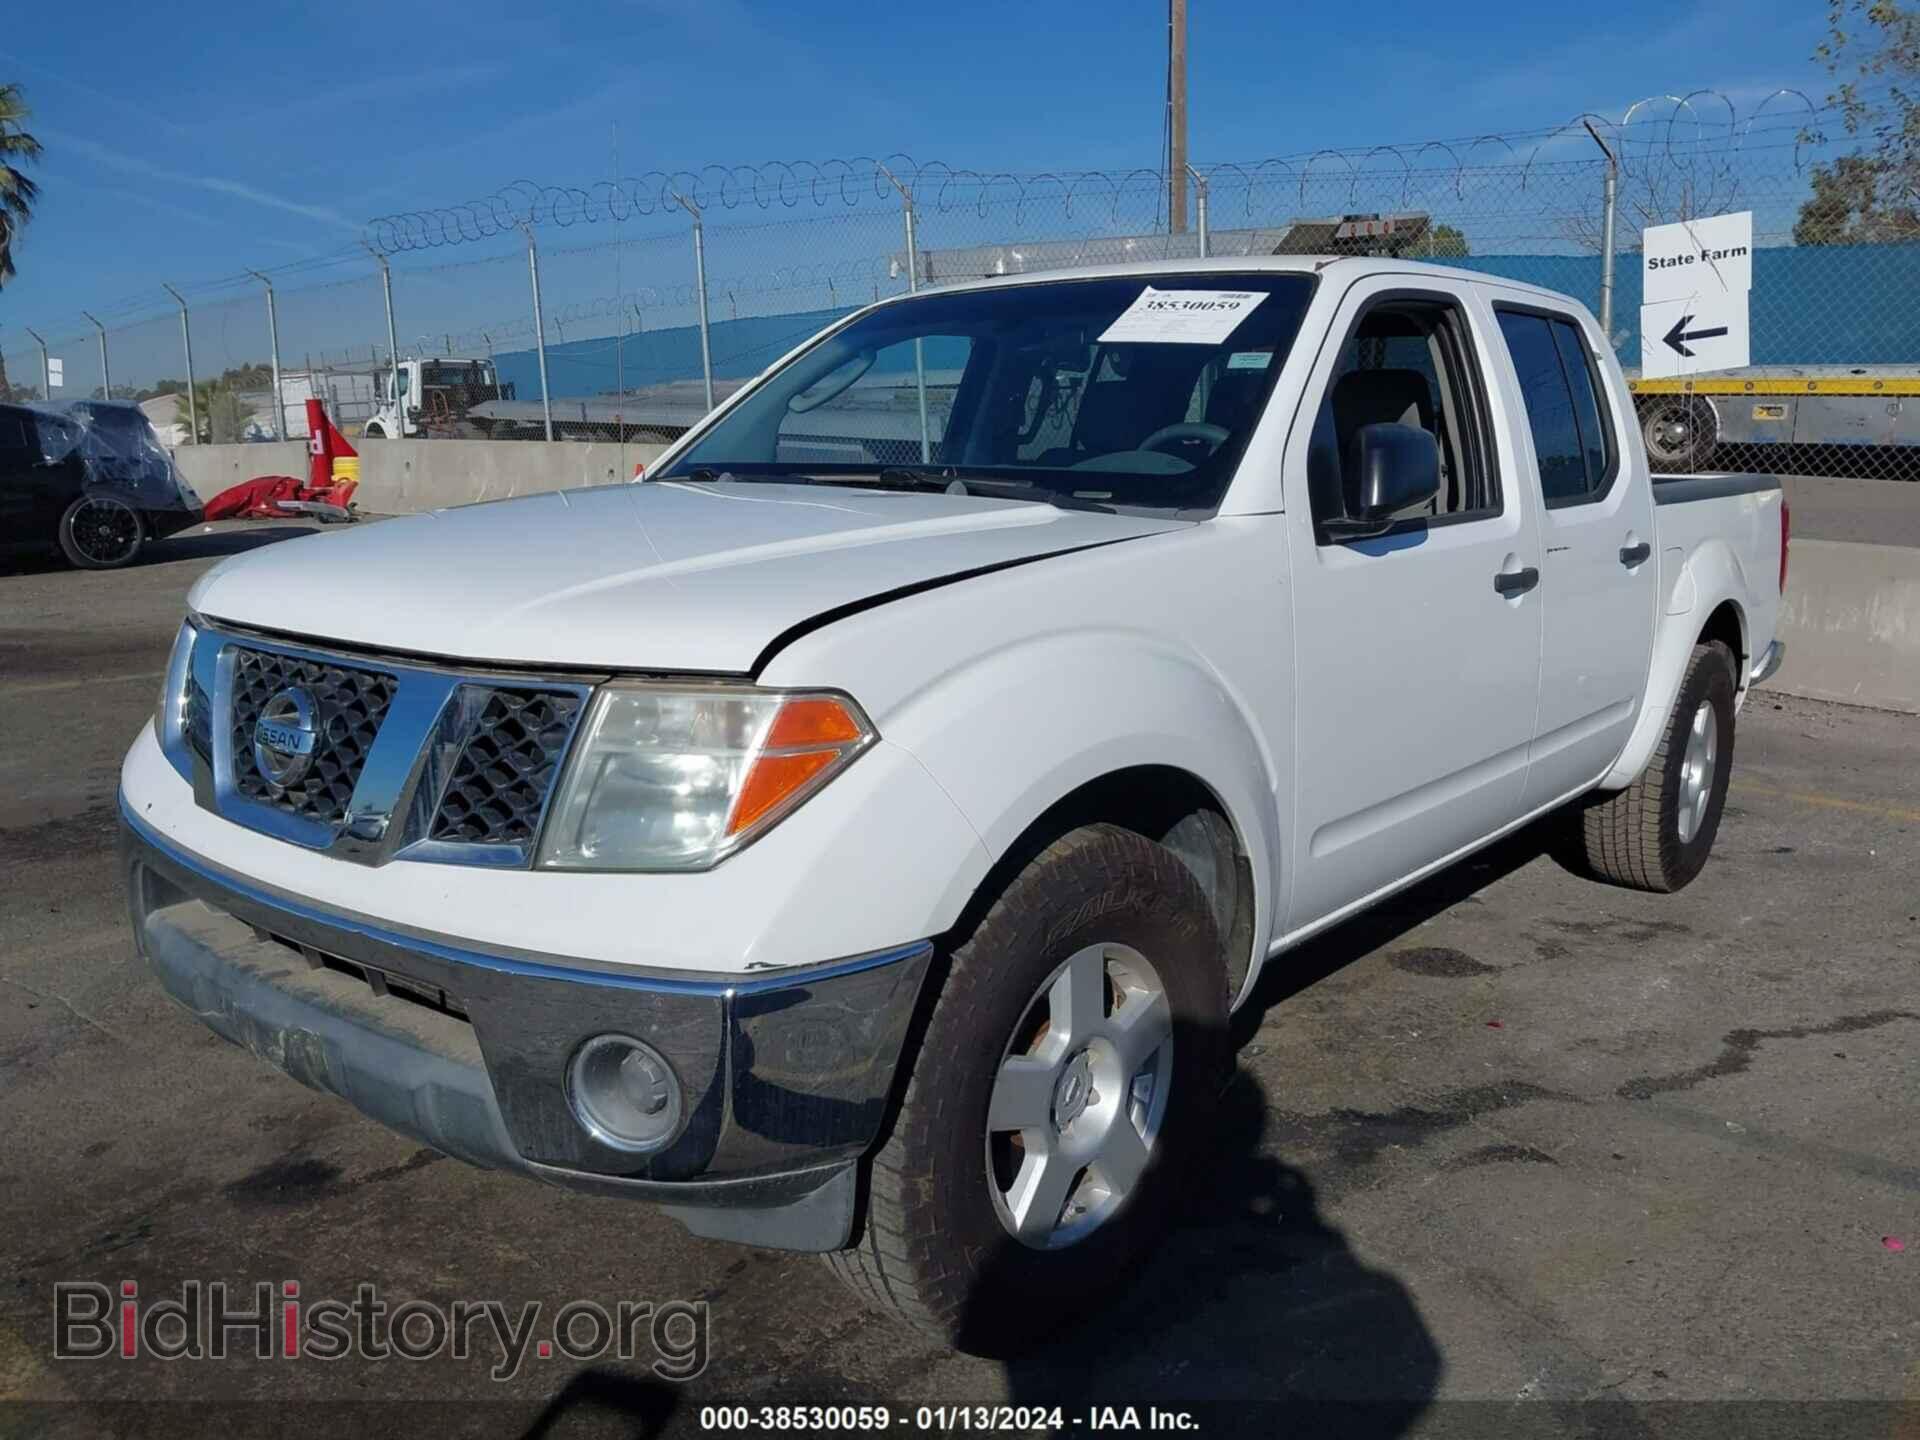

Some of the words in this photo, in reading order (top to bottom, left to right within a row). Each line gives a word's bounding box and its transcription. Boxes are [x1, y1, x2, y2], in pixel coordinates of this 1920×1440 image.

[1648, 254, 1695, 270] State
[1701, 246, 1747, 262] Farm
[1145, 300, 1241, 311] 38530059
